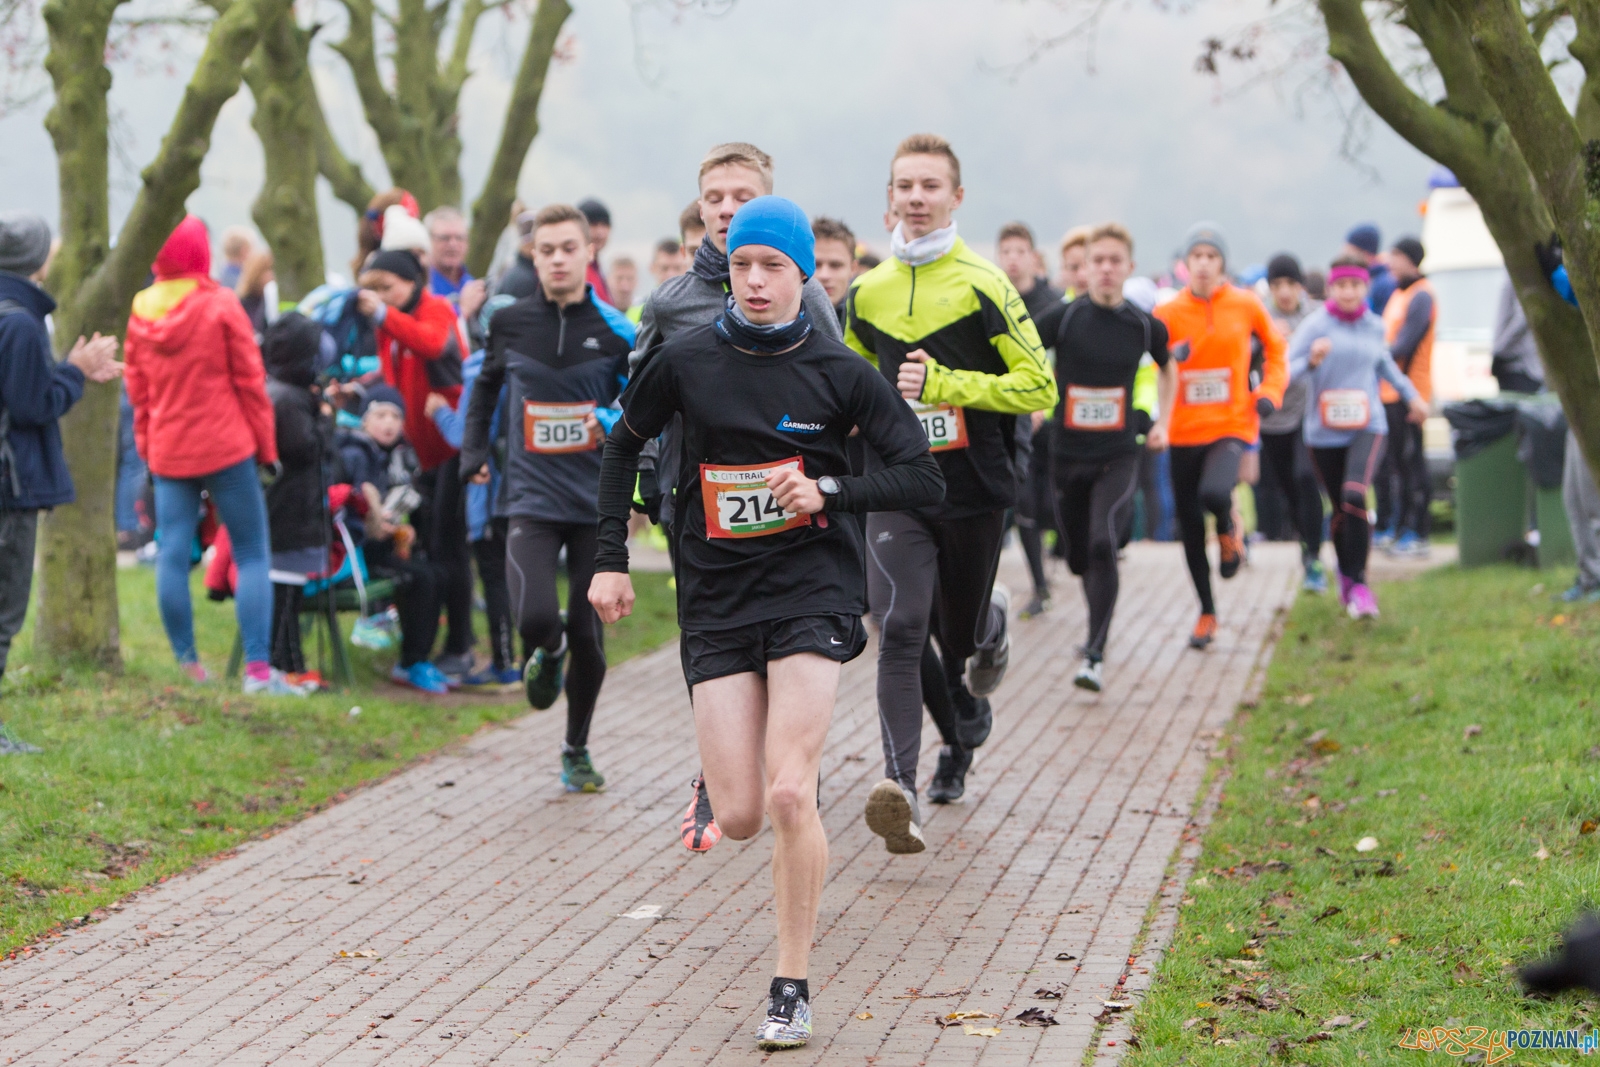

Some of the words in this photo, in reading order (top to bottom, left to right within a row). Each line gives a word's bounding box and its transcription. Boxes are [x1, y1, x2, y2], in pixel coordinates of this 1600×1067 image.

[1077, 402, 1114, 420] 330
[537, 423, 583, 443] 305
[726, 493, 784, 524] 214
